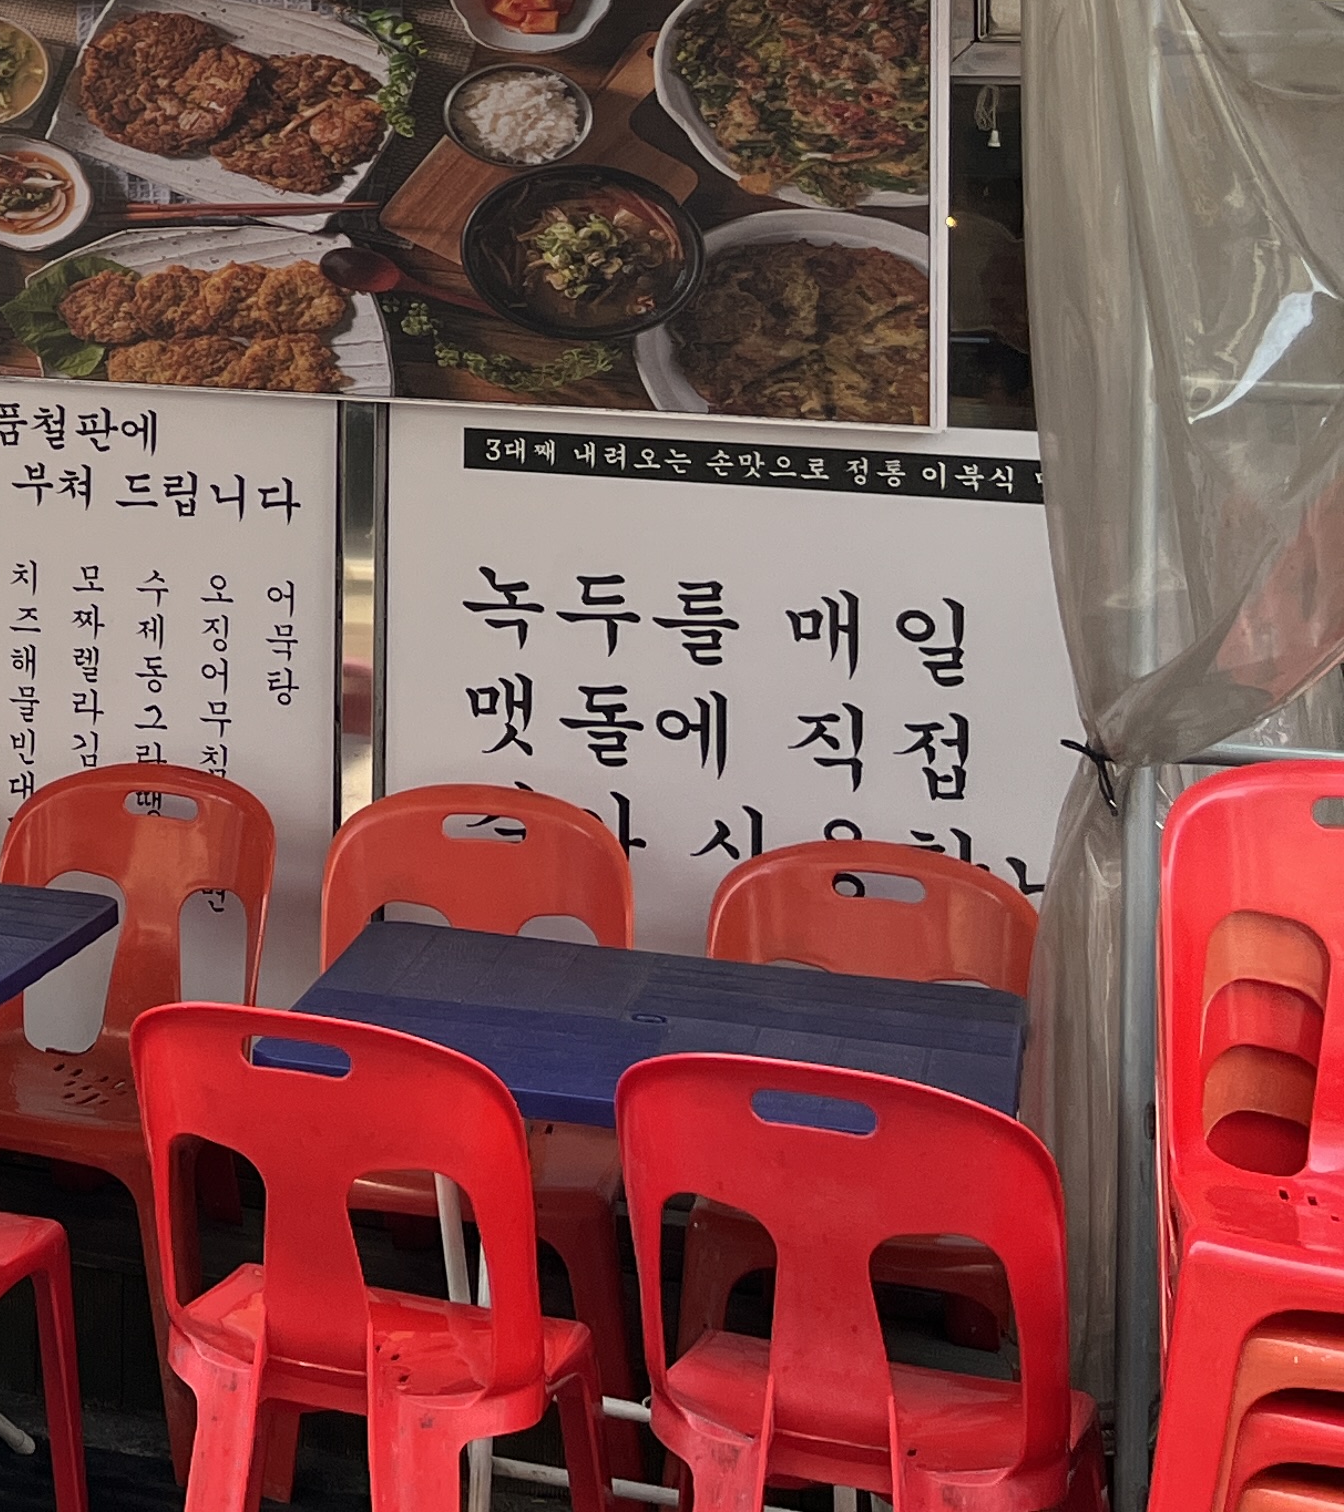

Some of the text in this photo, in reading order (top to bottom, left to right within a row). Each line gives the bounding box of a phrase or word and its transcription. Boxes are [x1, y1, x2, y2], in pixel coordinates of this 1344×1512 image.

[12, 461, 92, 511] 부쳐
[115, 470, 302, 526] 드립니다
[485, 438, 556, 466] 3대째
[574, 441, 692, 474] 내려오는
[706, 449, 830, 481] 손맛으로
[845, 456, 906, 487] 정통
[922, 461, 1014, 494] 이북식
[7, 559, 43, 802] 치즈해물빈대
[265, 580, 300, 707] 어묵탕
[462, 565, 965, 687] 녹두를 매일
[465, 672, 970, 802] 맷돌에 직접
